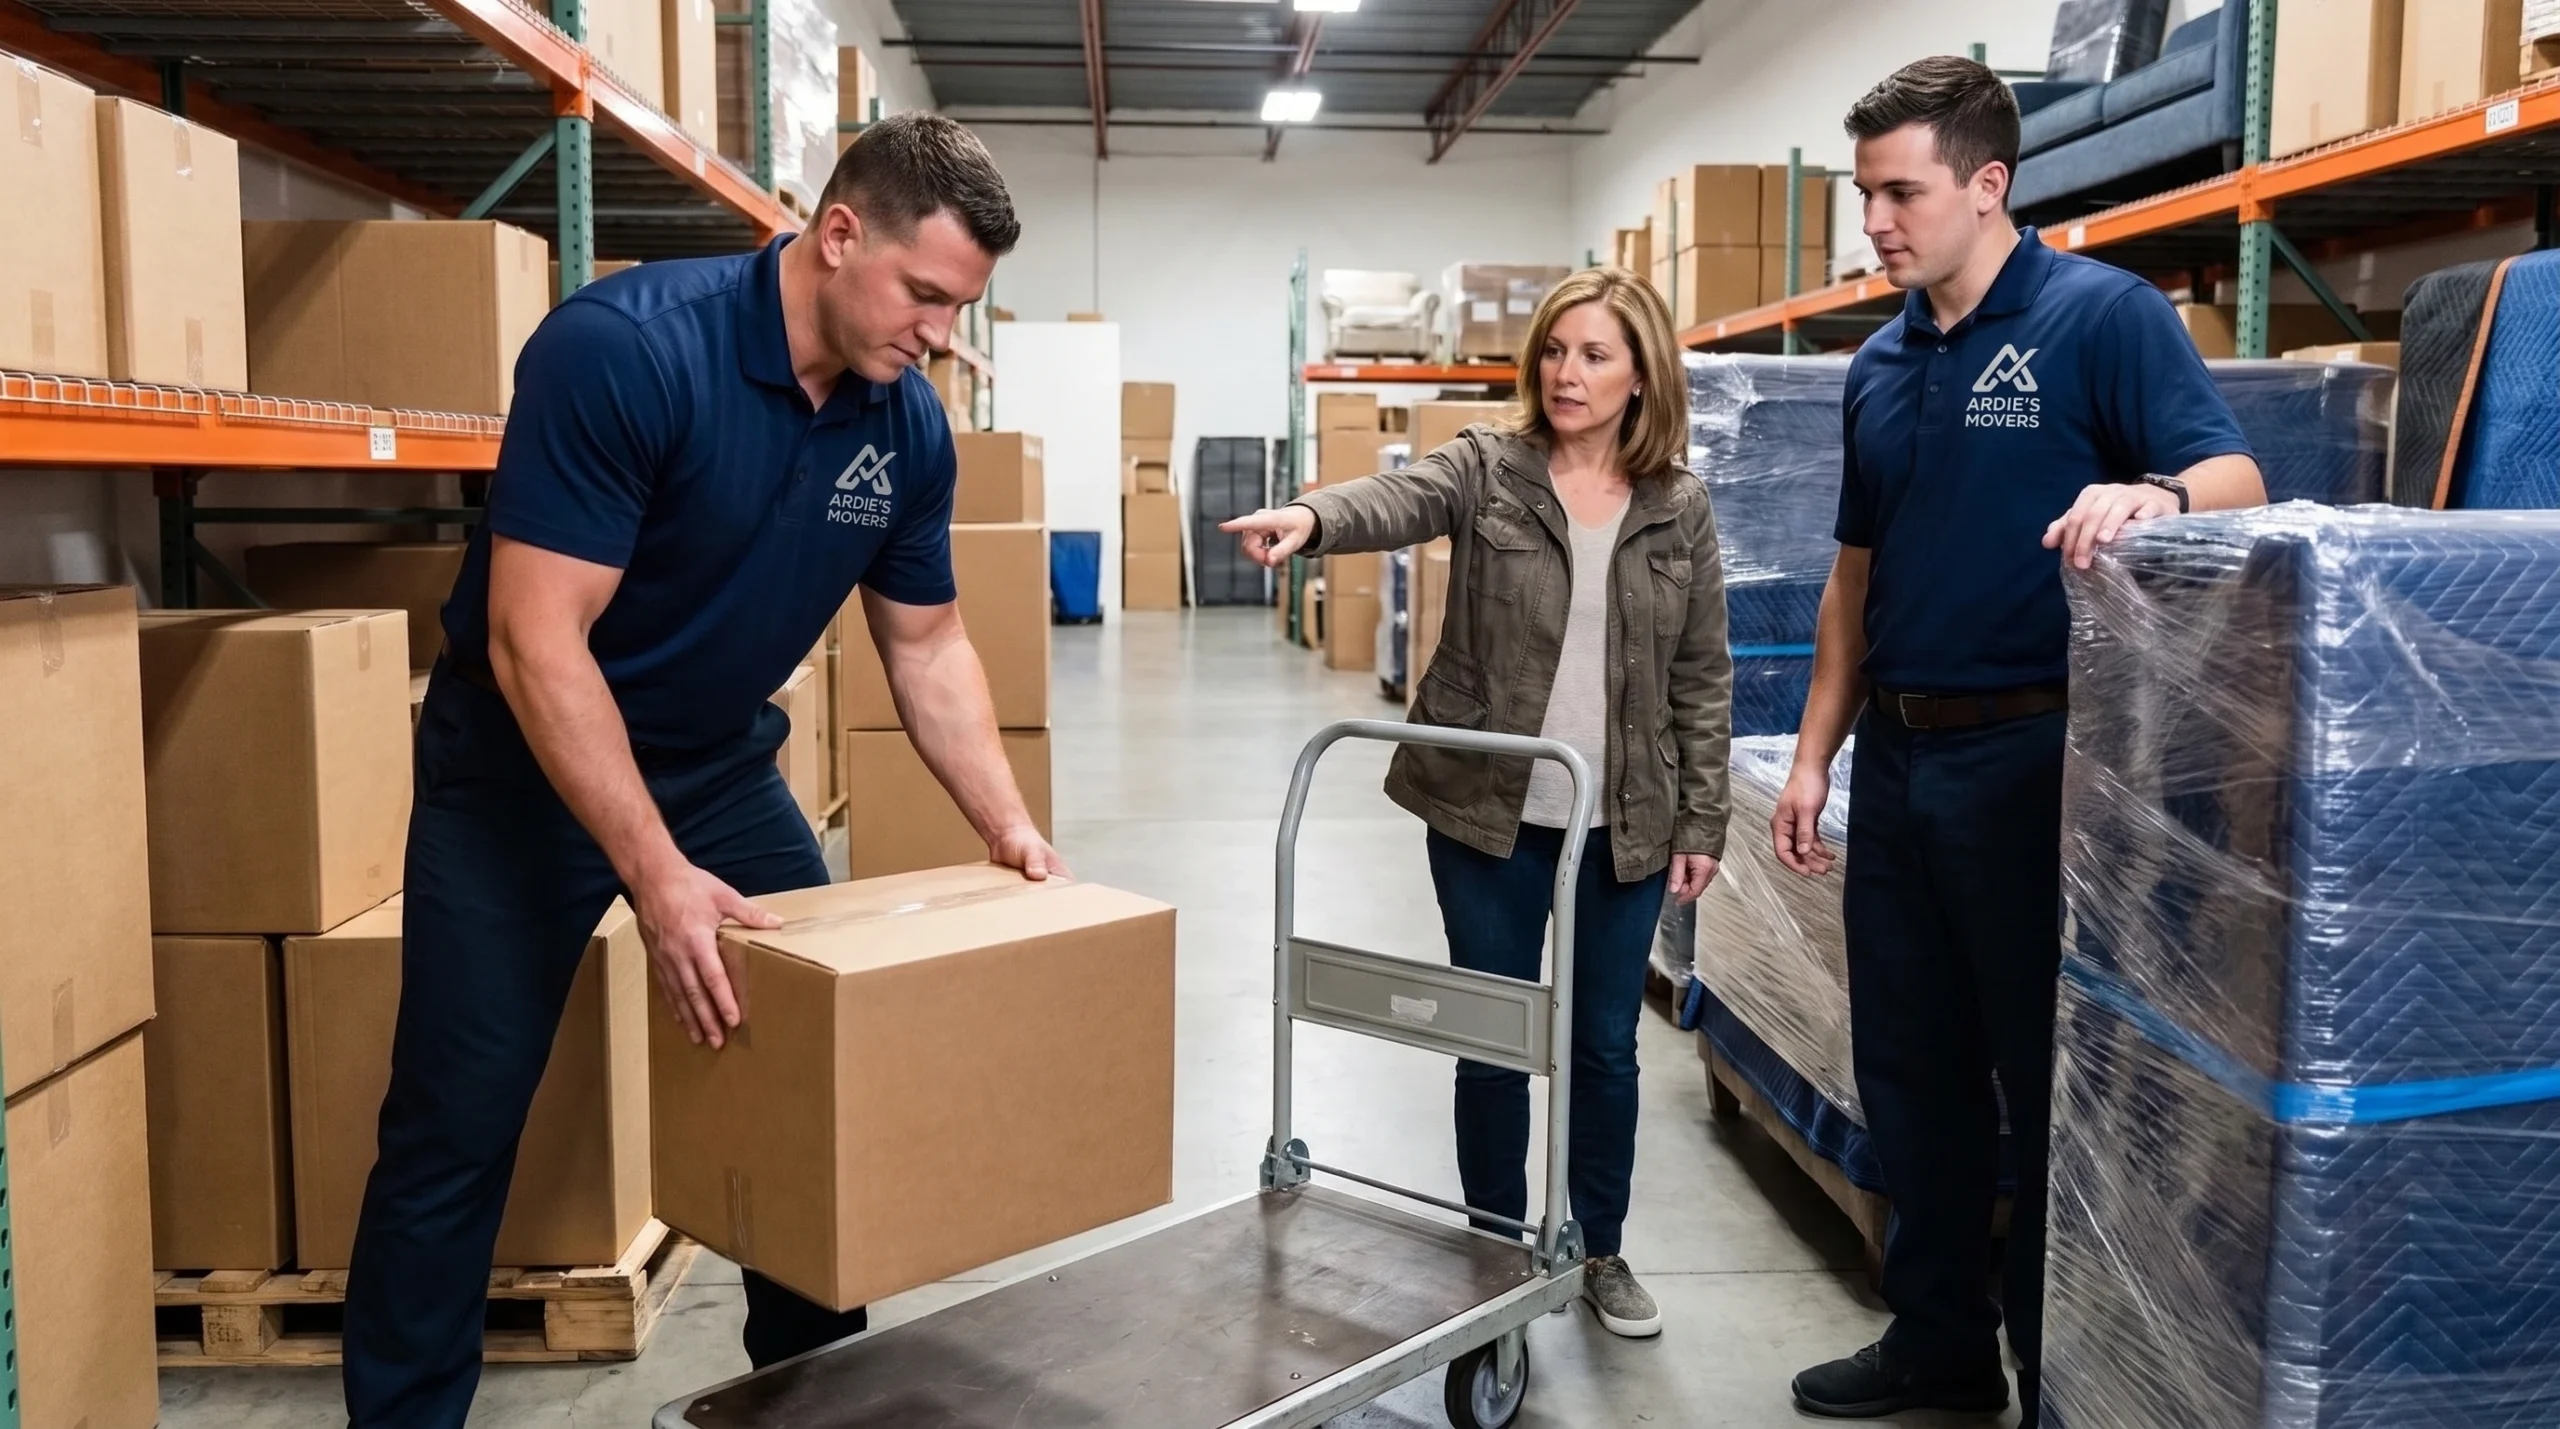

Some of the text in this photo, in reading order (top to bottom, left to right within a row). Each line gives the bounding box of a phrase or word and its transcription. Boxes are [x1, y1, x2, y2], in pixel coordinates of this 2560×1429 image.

[1966, 397, 2041, 412] ARDIE'S
[1965, 414, 2040, 428] MOVERS
[828, 493, 892, 514] ARDIE'S
[827, 509, 888, 528] MOVERS
